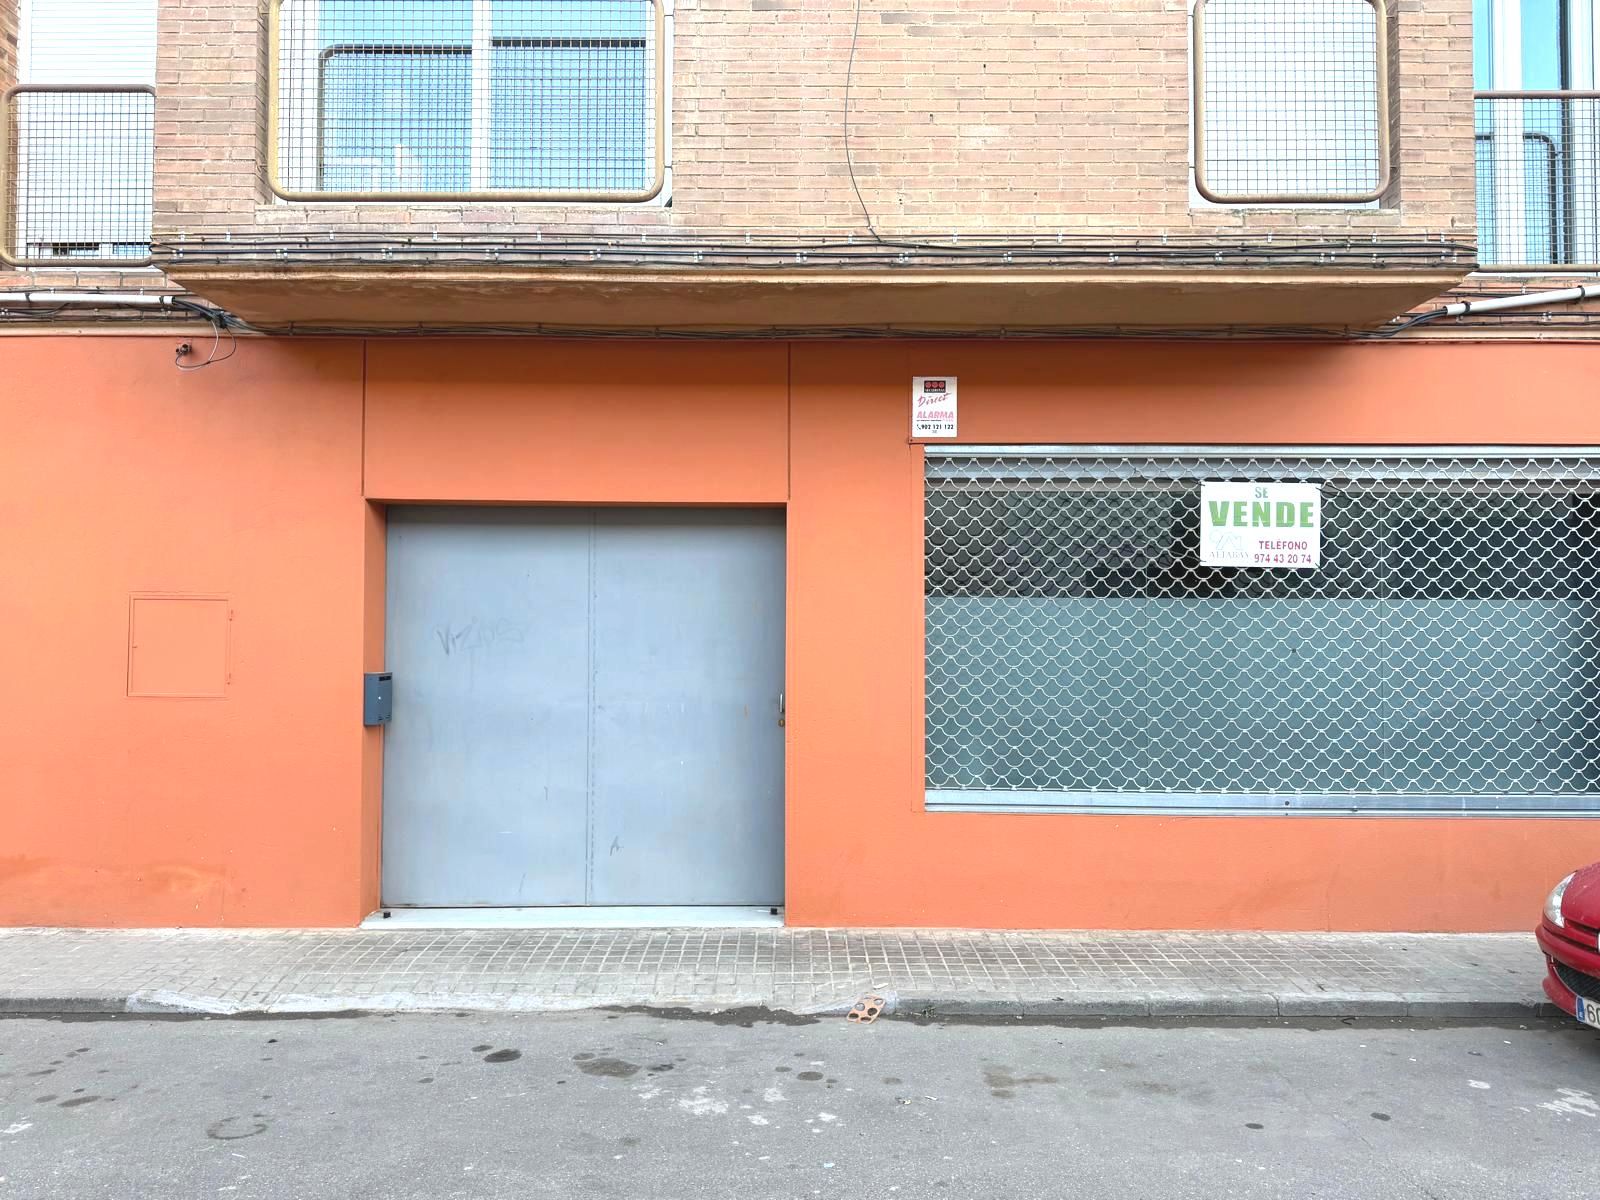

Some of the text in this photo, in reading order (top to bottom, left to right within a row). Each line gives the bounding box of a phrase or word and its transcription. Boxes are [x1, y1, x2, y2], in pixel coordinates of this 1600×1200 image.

[916, 411, 954, 419] ALARMA
[1255, 487, 1269, 498] SE
[1208, 501, 1315, 528] VENDE
[1254, 553, 1312, 564] 974 43 20 74
